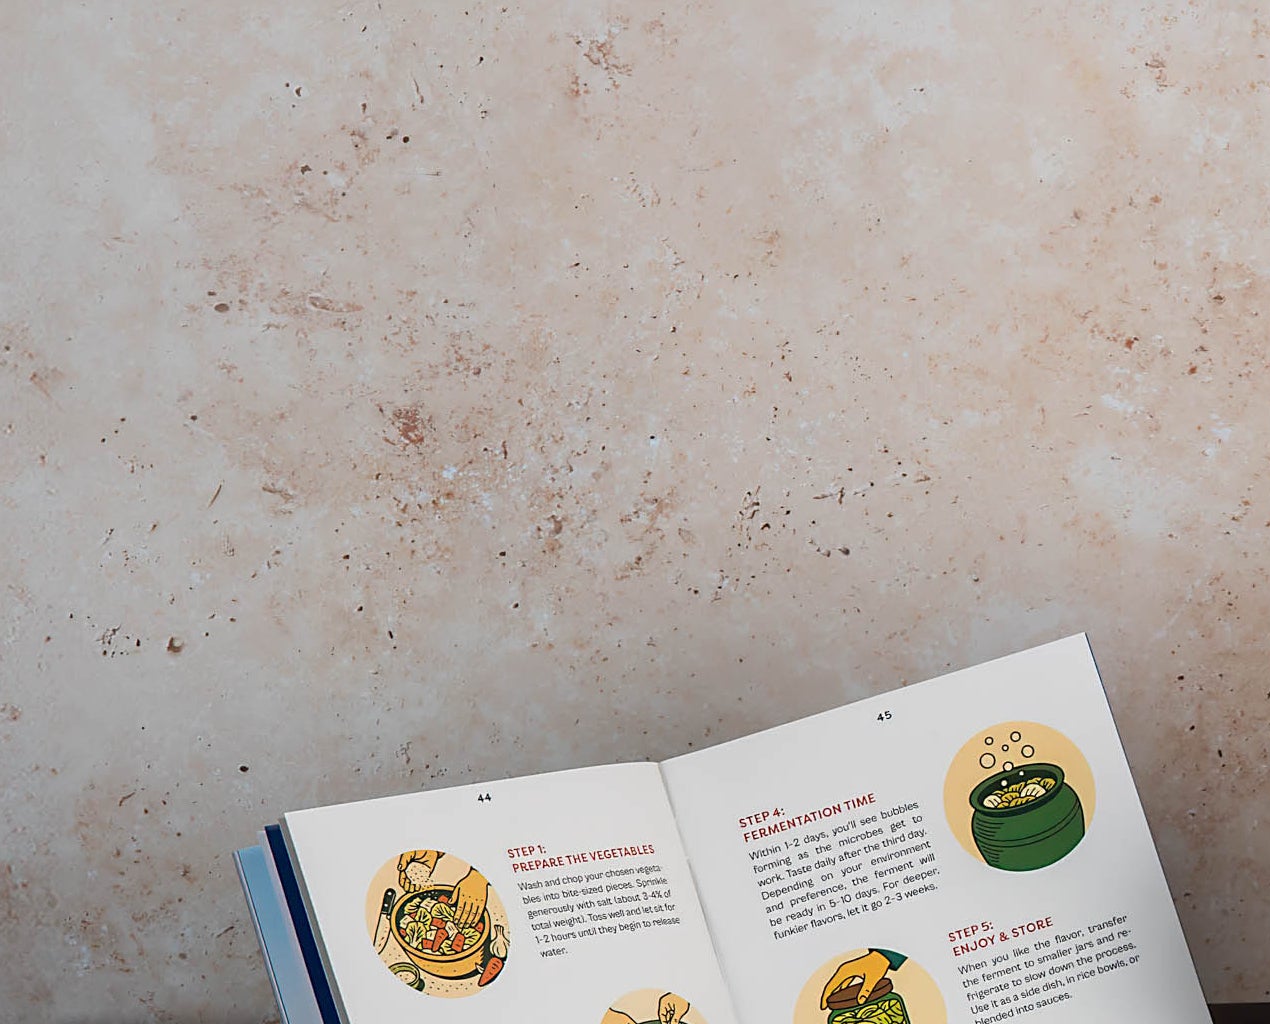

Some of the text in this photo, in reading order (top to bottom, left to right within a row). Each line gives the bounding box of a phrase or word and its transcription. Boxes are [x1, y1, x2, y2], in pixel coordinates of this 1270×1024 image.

[877, 710, 892, 722] 45
[477, 792, 492, 803] 44
[738, 807, 785, 828] STEP 4:
[743, 792, 876, 843] FERMENTATION TIME
[748, 845, 782, 861] Within
[859, 815, 878, 826] see
[879, 802, 919, 820] bubbles
[507, 844, 547, 859] STEP 1:
[511, 844, 655, 874] PREPARE THE VEGETABLES
[550, 931, 577, 942] hours
[577, 927, 597, 938] until
[597, 925, 617, 935] they
[617, 920, 642, 932] begin
[641, 920, 652, 928] to
[652, 917, 680, 926] release
[948, 920, 994, 943] STEP 5:
[952, 916, 1054, 957] ENJOY & STORE
[539, 947, 568, 958] water.
[957, 915, 1127, 975] When you like the flavor, transfer
